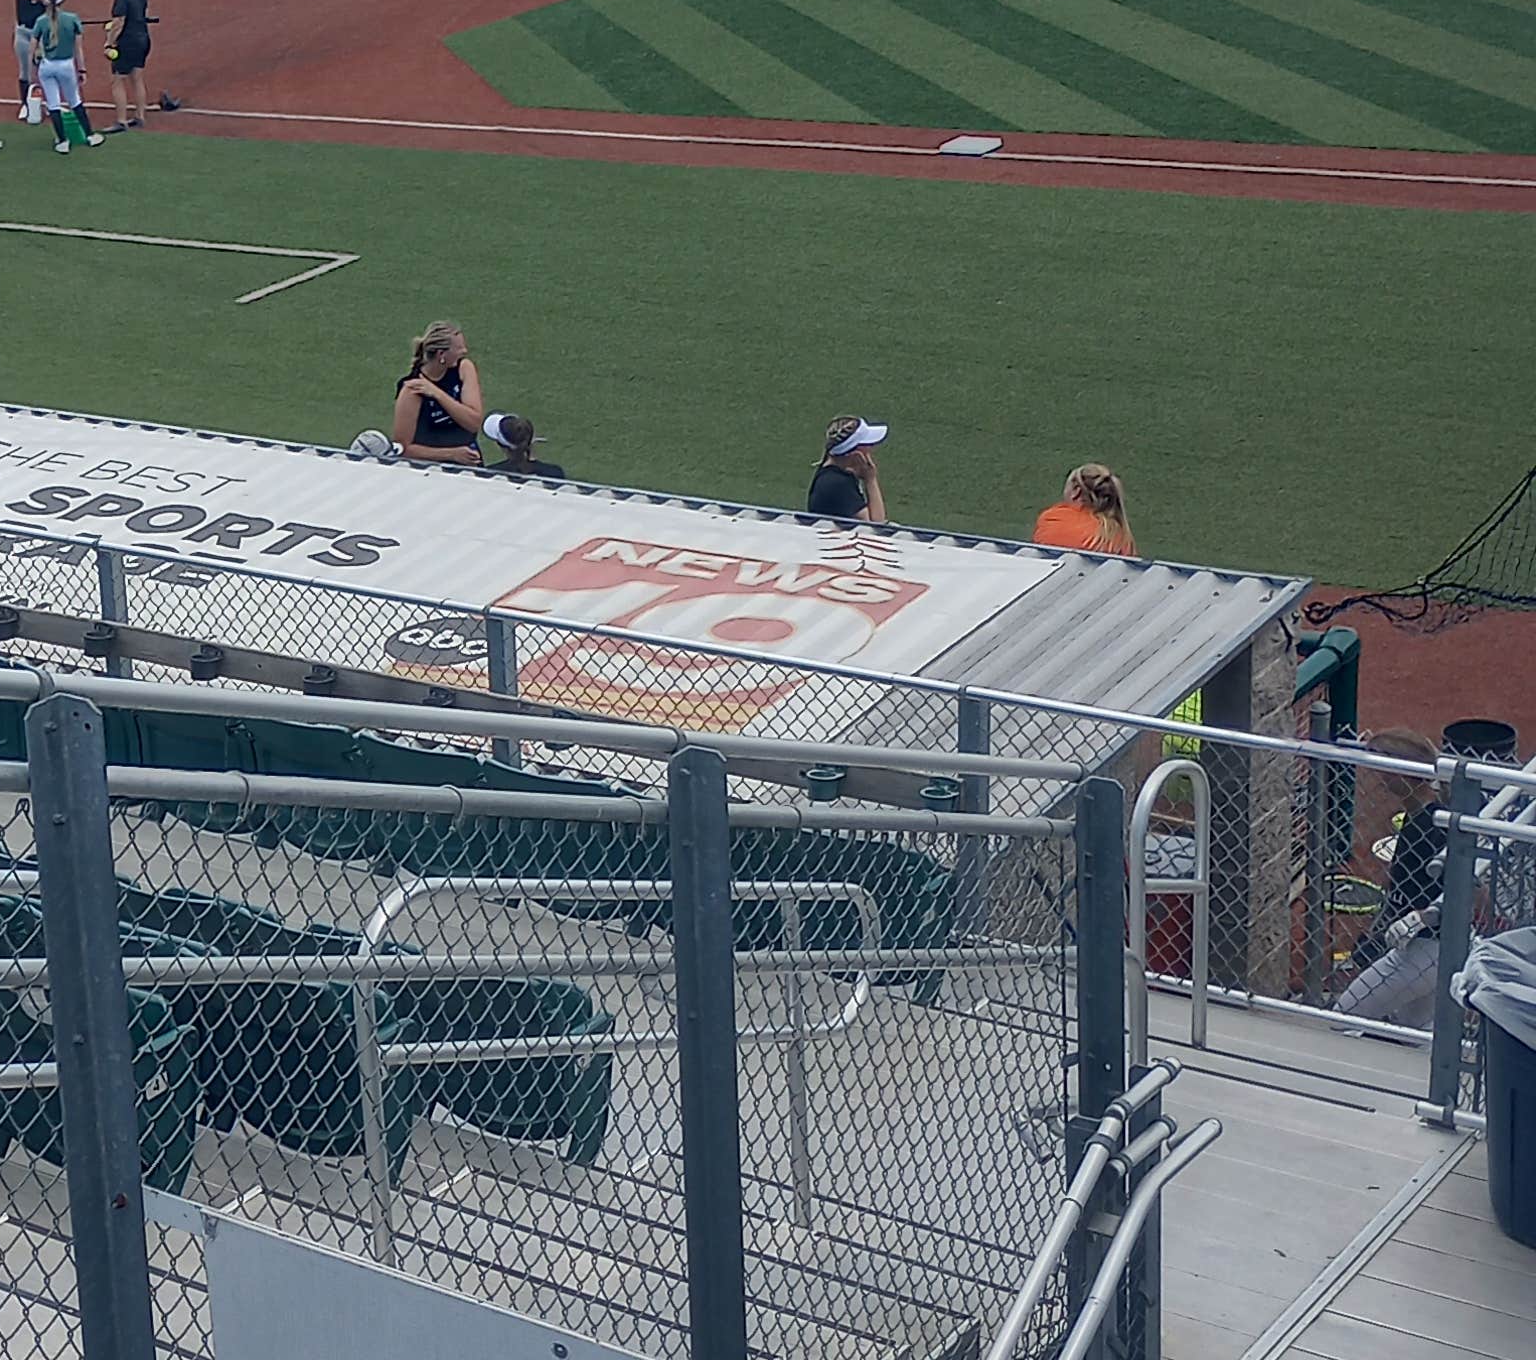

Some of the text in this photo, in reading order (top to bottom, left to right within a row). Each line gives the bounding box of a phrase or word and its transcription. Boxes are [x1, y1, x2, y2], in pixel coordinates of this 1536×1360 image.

[80, 457, 247, 498] BEST
[4, 485, 402, 569] SPORTS
[582, 539, 903, 606] NEWS
